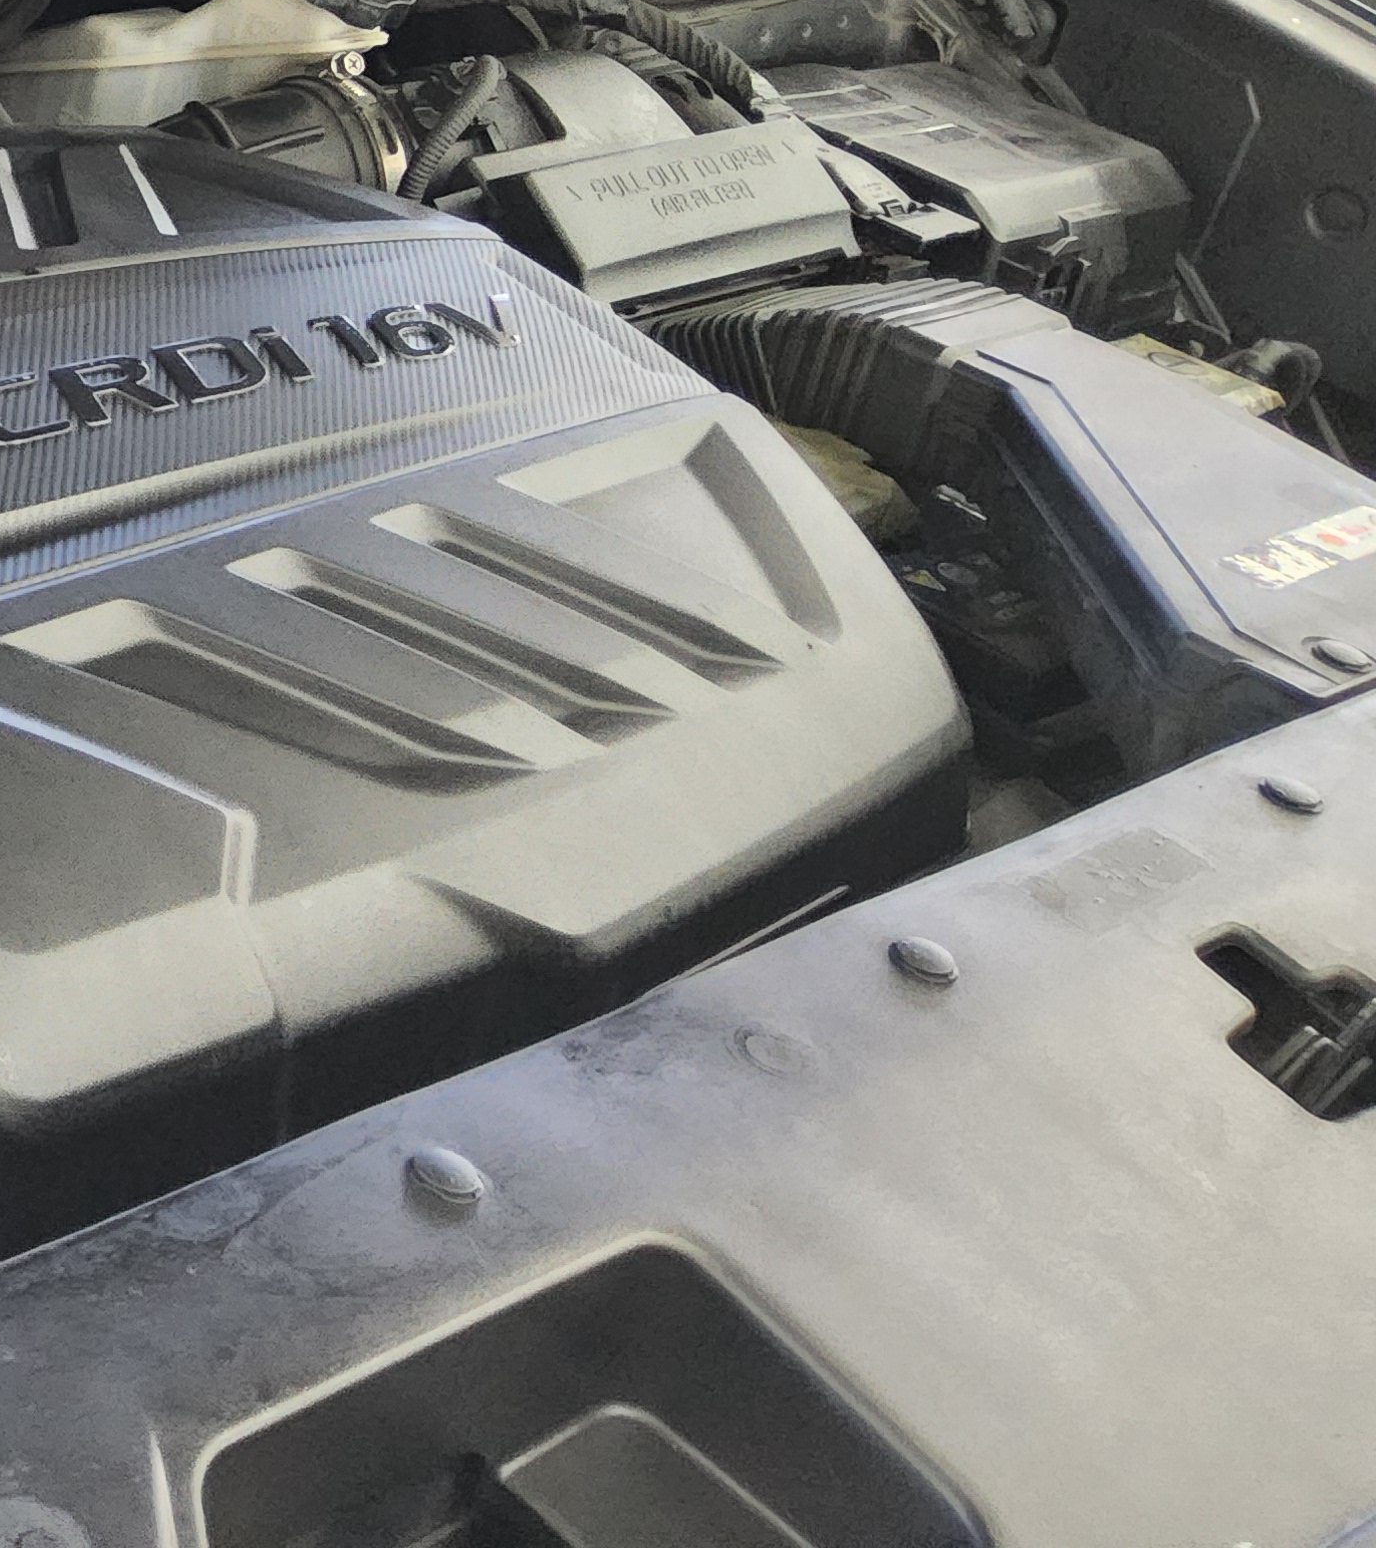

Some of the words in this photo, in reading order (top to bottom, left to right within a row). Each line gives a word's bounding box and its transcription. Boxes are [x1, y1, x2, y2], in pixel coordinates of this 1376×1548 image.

[589, 171, 650, 202] PULL
[646, 160, 690, 188] OUT
[693, 155, 722, 178] TO
[720, 143, 777, 172] OPEN
[307, 293, 520, 368] 16V
